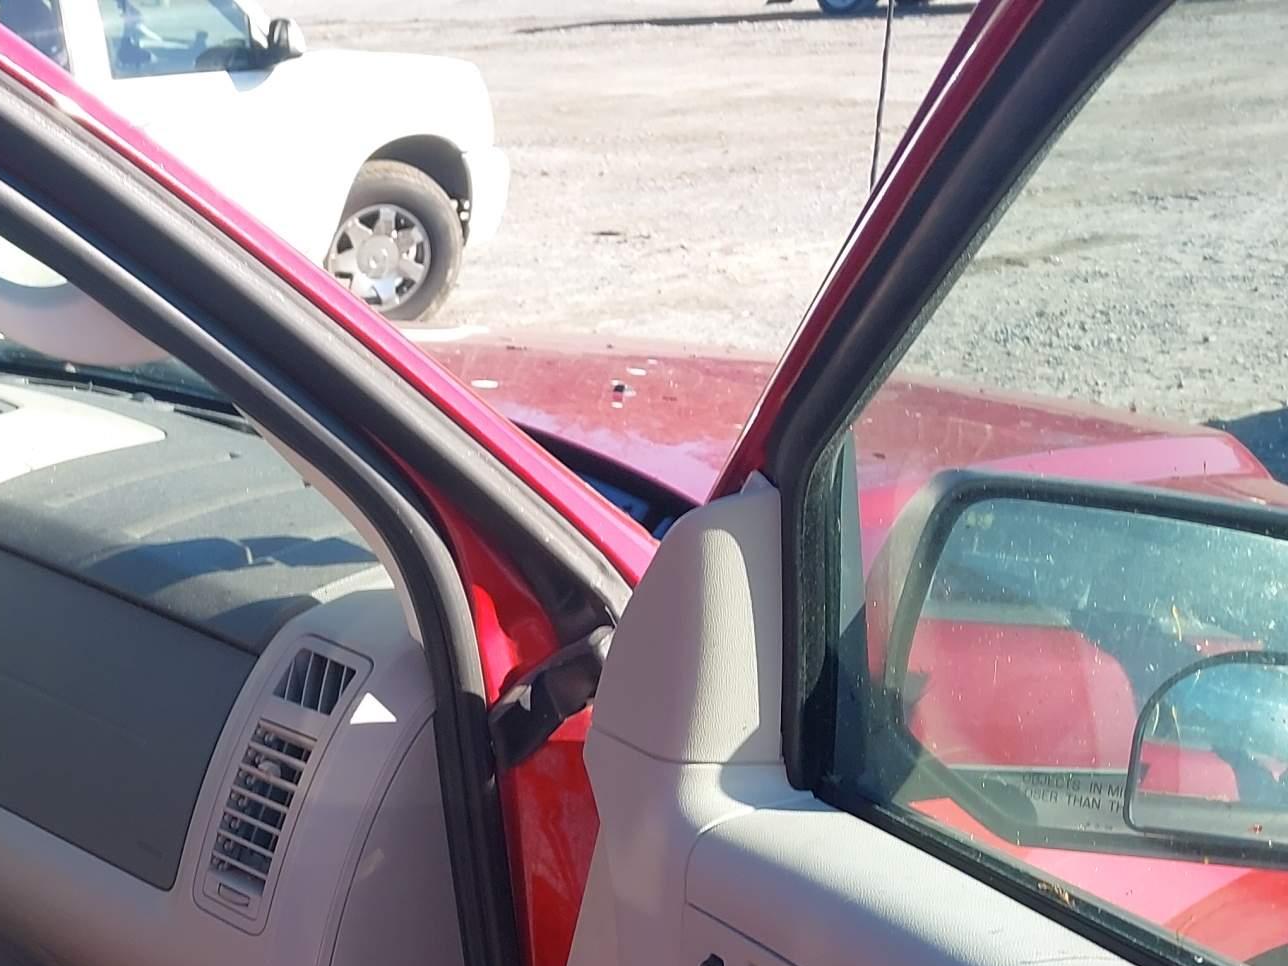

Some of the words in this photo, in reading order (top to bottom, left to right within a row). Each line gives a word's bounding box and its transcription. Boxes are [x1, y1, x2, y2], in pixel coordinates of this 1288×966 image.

[1022, 773, 1081, 791] OBJECTS
[1089, 782, 1103, 795] IN
[1107, 784, 1123, 798] MI
[1024, 787, 1059, 803] OSER
[1067, 794, 1101, 811] THAN
[1109, 800, 1122, 814] TH
